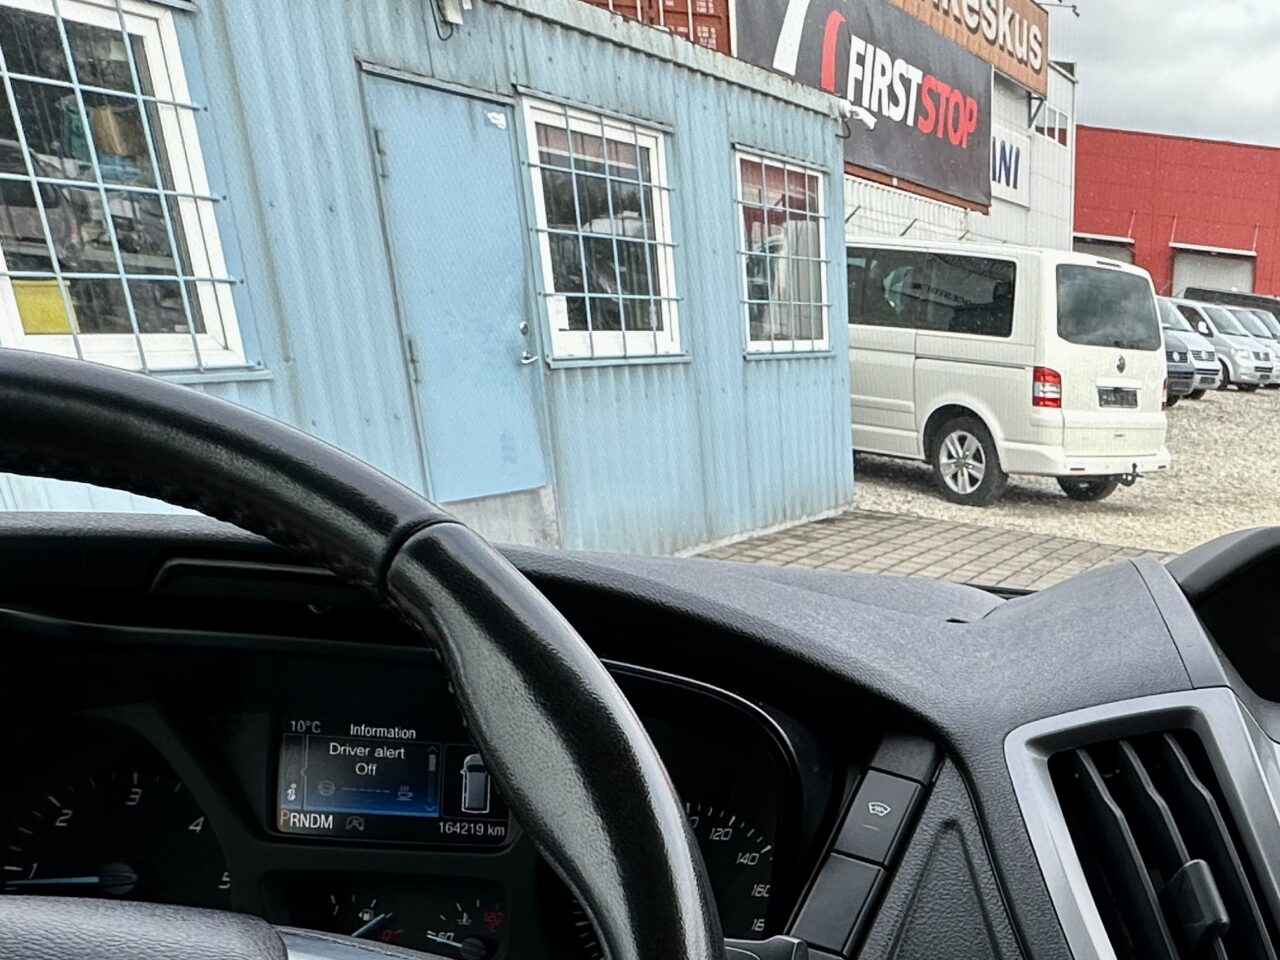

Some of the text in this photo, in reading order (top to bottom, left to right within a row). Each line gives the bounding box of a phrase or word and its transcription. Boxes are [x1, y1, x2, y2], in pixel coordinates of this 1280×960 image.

[930, 0, 1044, 74] eskus
[991, 136, 1020, 190] NI
[290, 720, 321, 733] 10°C
[350, 723, 417, 739] Information
[329, 742, 406, 759] Driver alert
[355, 763, 377, 776] Off
[125, 788, 142, 805] 3
[55, 809, 73, 827] 2
[188, 816, 204, 833] 4
[439, 822, 505, 837] 164219 km
[709, 827, 733, 841] 120
[735, 852, 760, 866] 140
